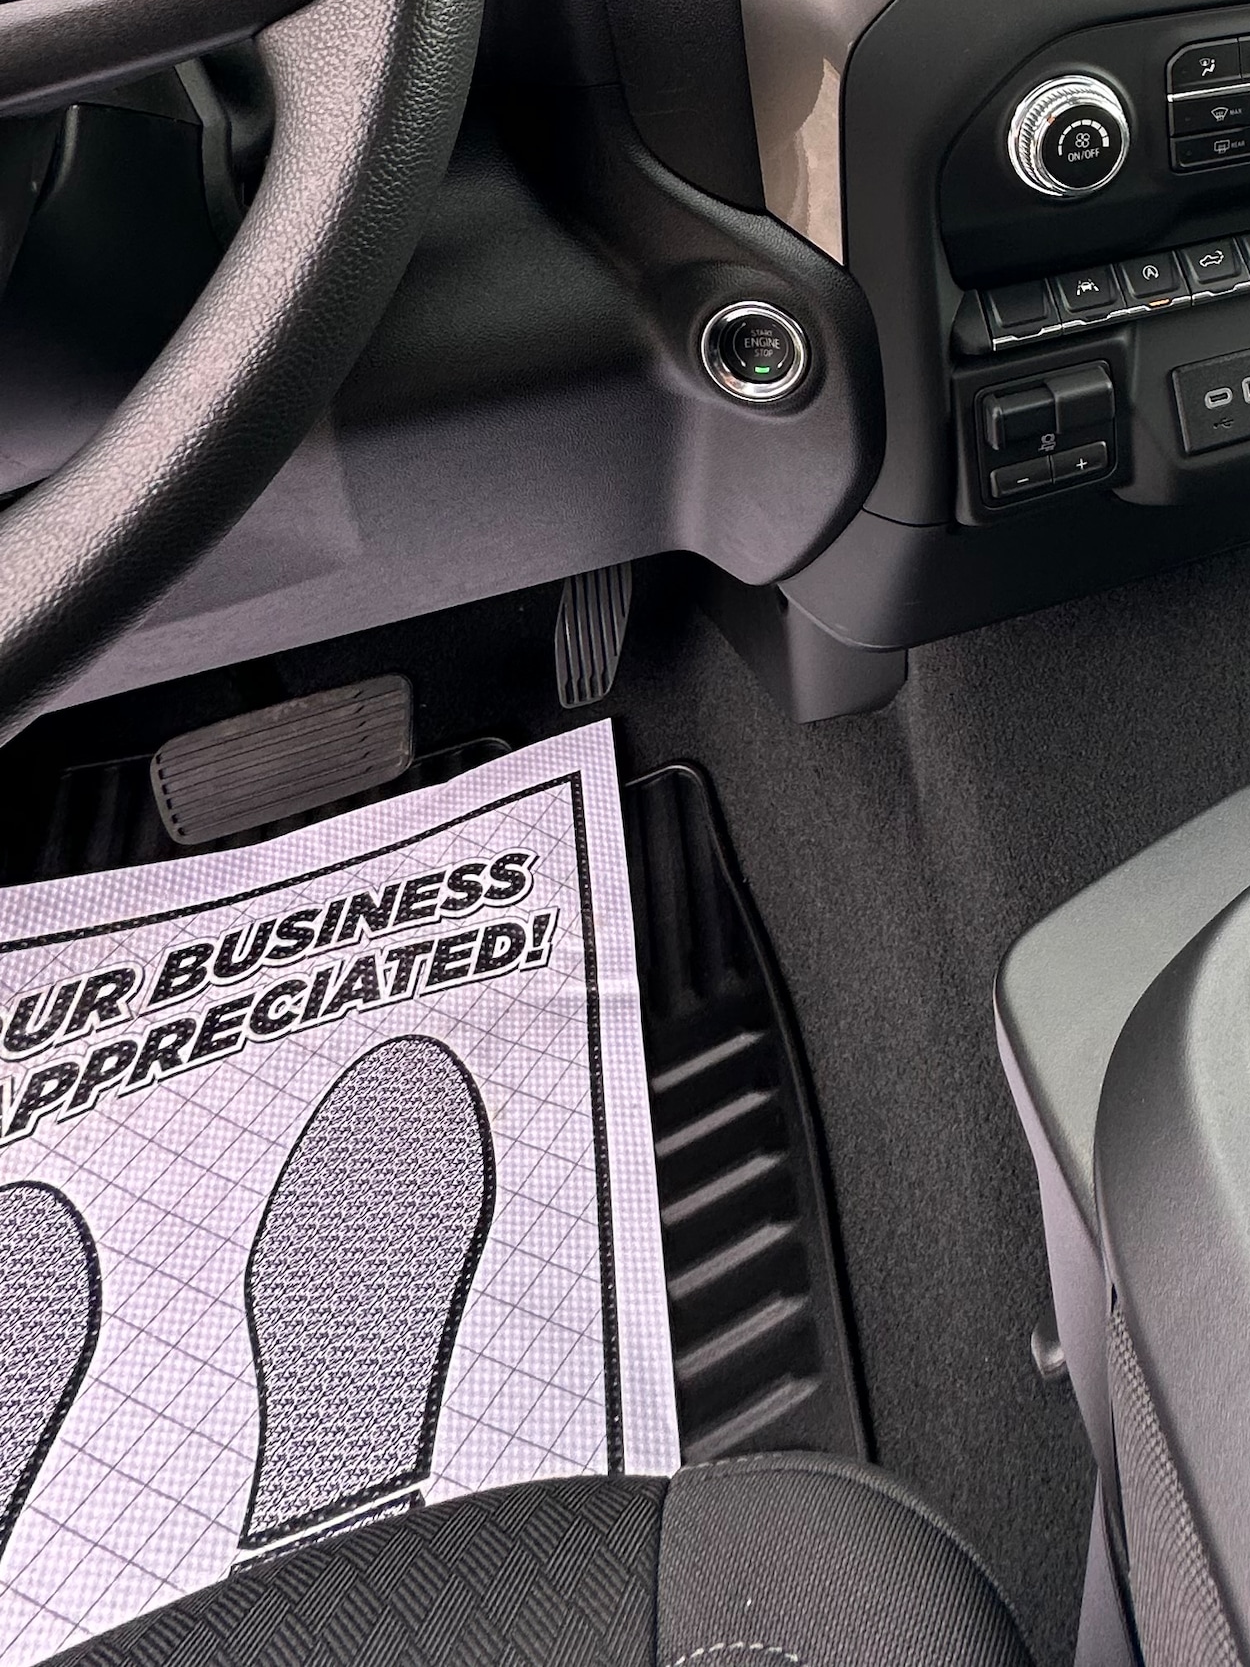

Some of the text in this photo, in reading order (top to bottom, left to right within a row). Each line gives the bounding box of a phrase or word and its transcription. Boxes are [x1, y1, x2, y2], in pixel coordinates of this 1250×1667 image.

[1067, 149, 1100, 163] ON/OFF
[744, 337, 781, 350] ENGINE
[754, 349, 774, 358] STOP
[0, 851, 539, 1055] UR BUSINESS
[0, 909, 558, 1139] PPRECIATED!
